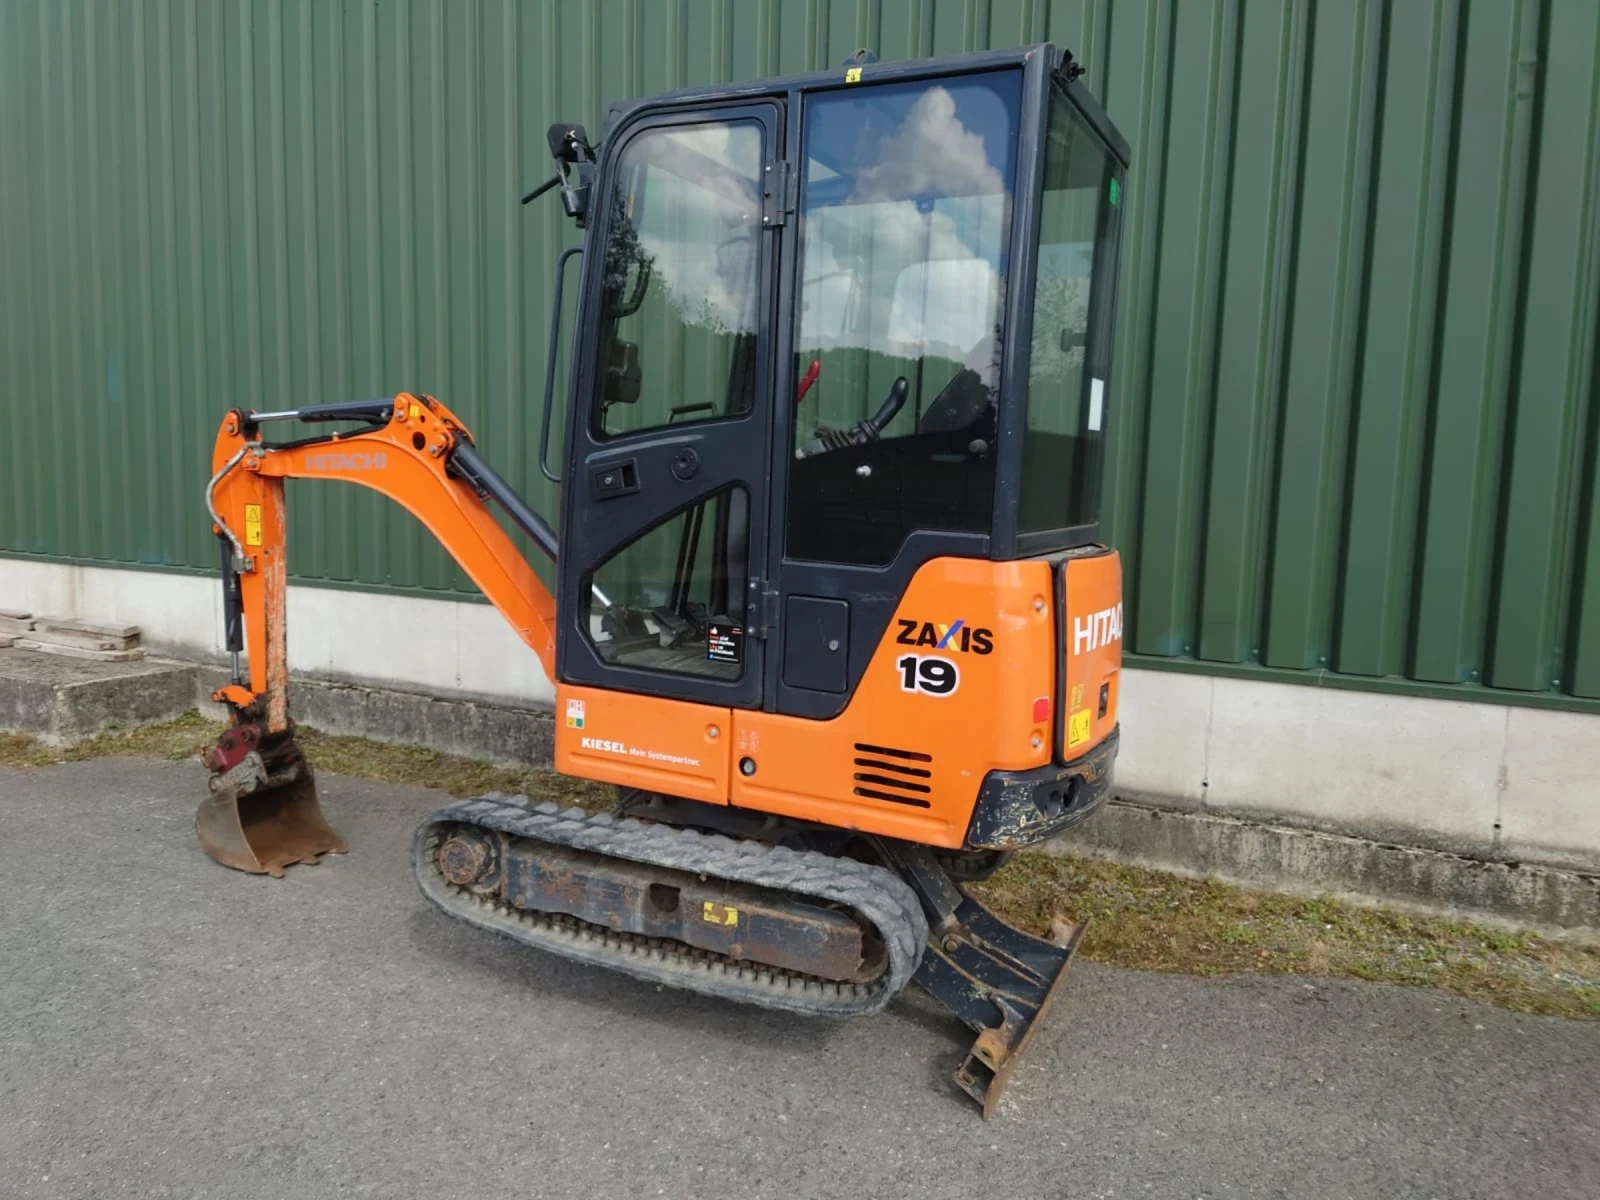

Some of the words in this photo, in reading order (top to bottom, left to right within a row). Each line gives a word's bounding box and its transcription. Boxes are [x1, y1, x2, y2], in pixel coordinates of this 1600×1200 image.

[305, 451, 387, 471] HITACHI
[896, 619, 993, 655] ZAXIS
[897, 654, 961, 696] 19
[581, 737, 628, 754] KIESEL
[629, 746, 647, 757] Mein
[648, 748, 701, 767] Systempartner.
